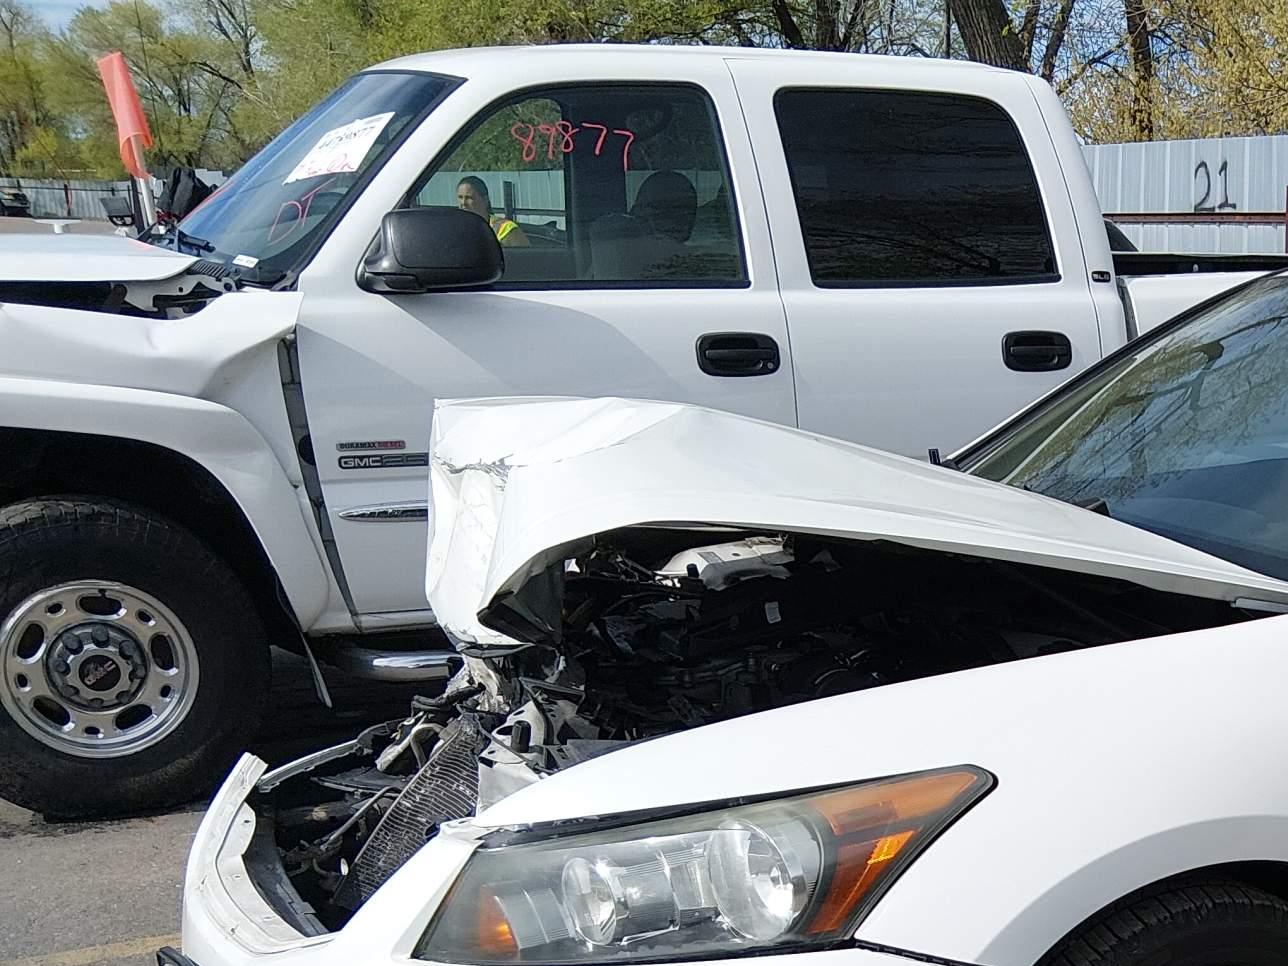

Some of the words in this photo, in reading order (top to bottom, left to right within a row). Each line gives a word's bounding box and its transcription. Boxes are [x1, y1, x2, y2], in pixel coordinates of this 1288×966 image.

[510, 120, 634, 172] 89877
[1193, 160, 1237, 213] 21
[341, 457, 383, 468] GMC
